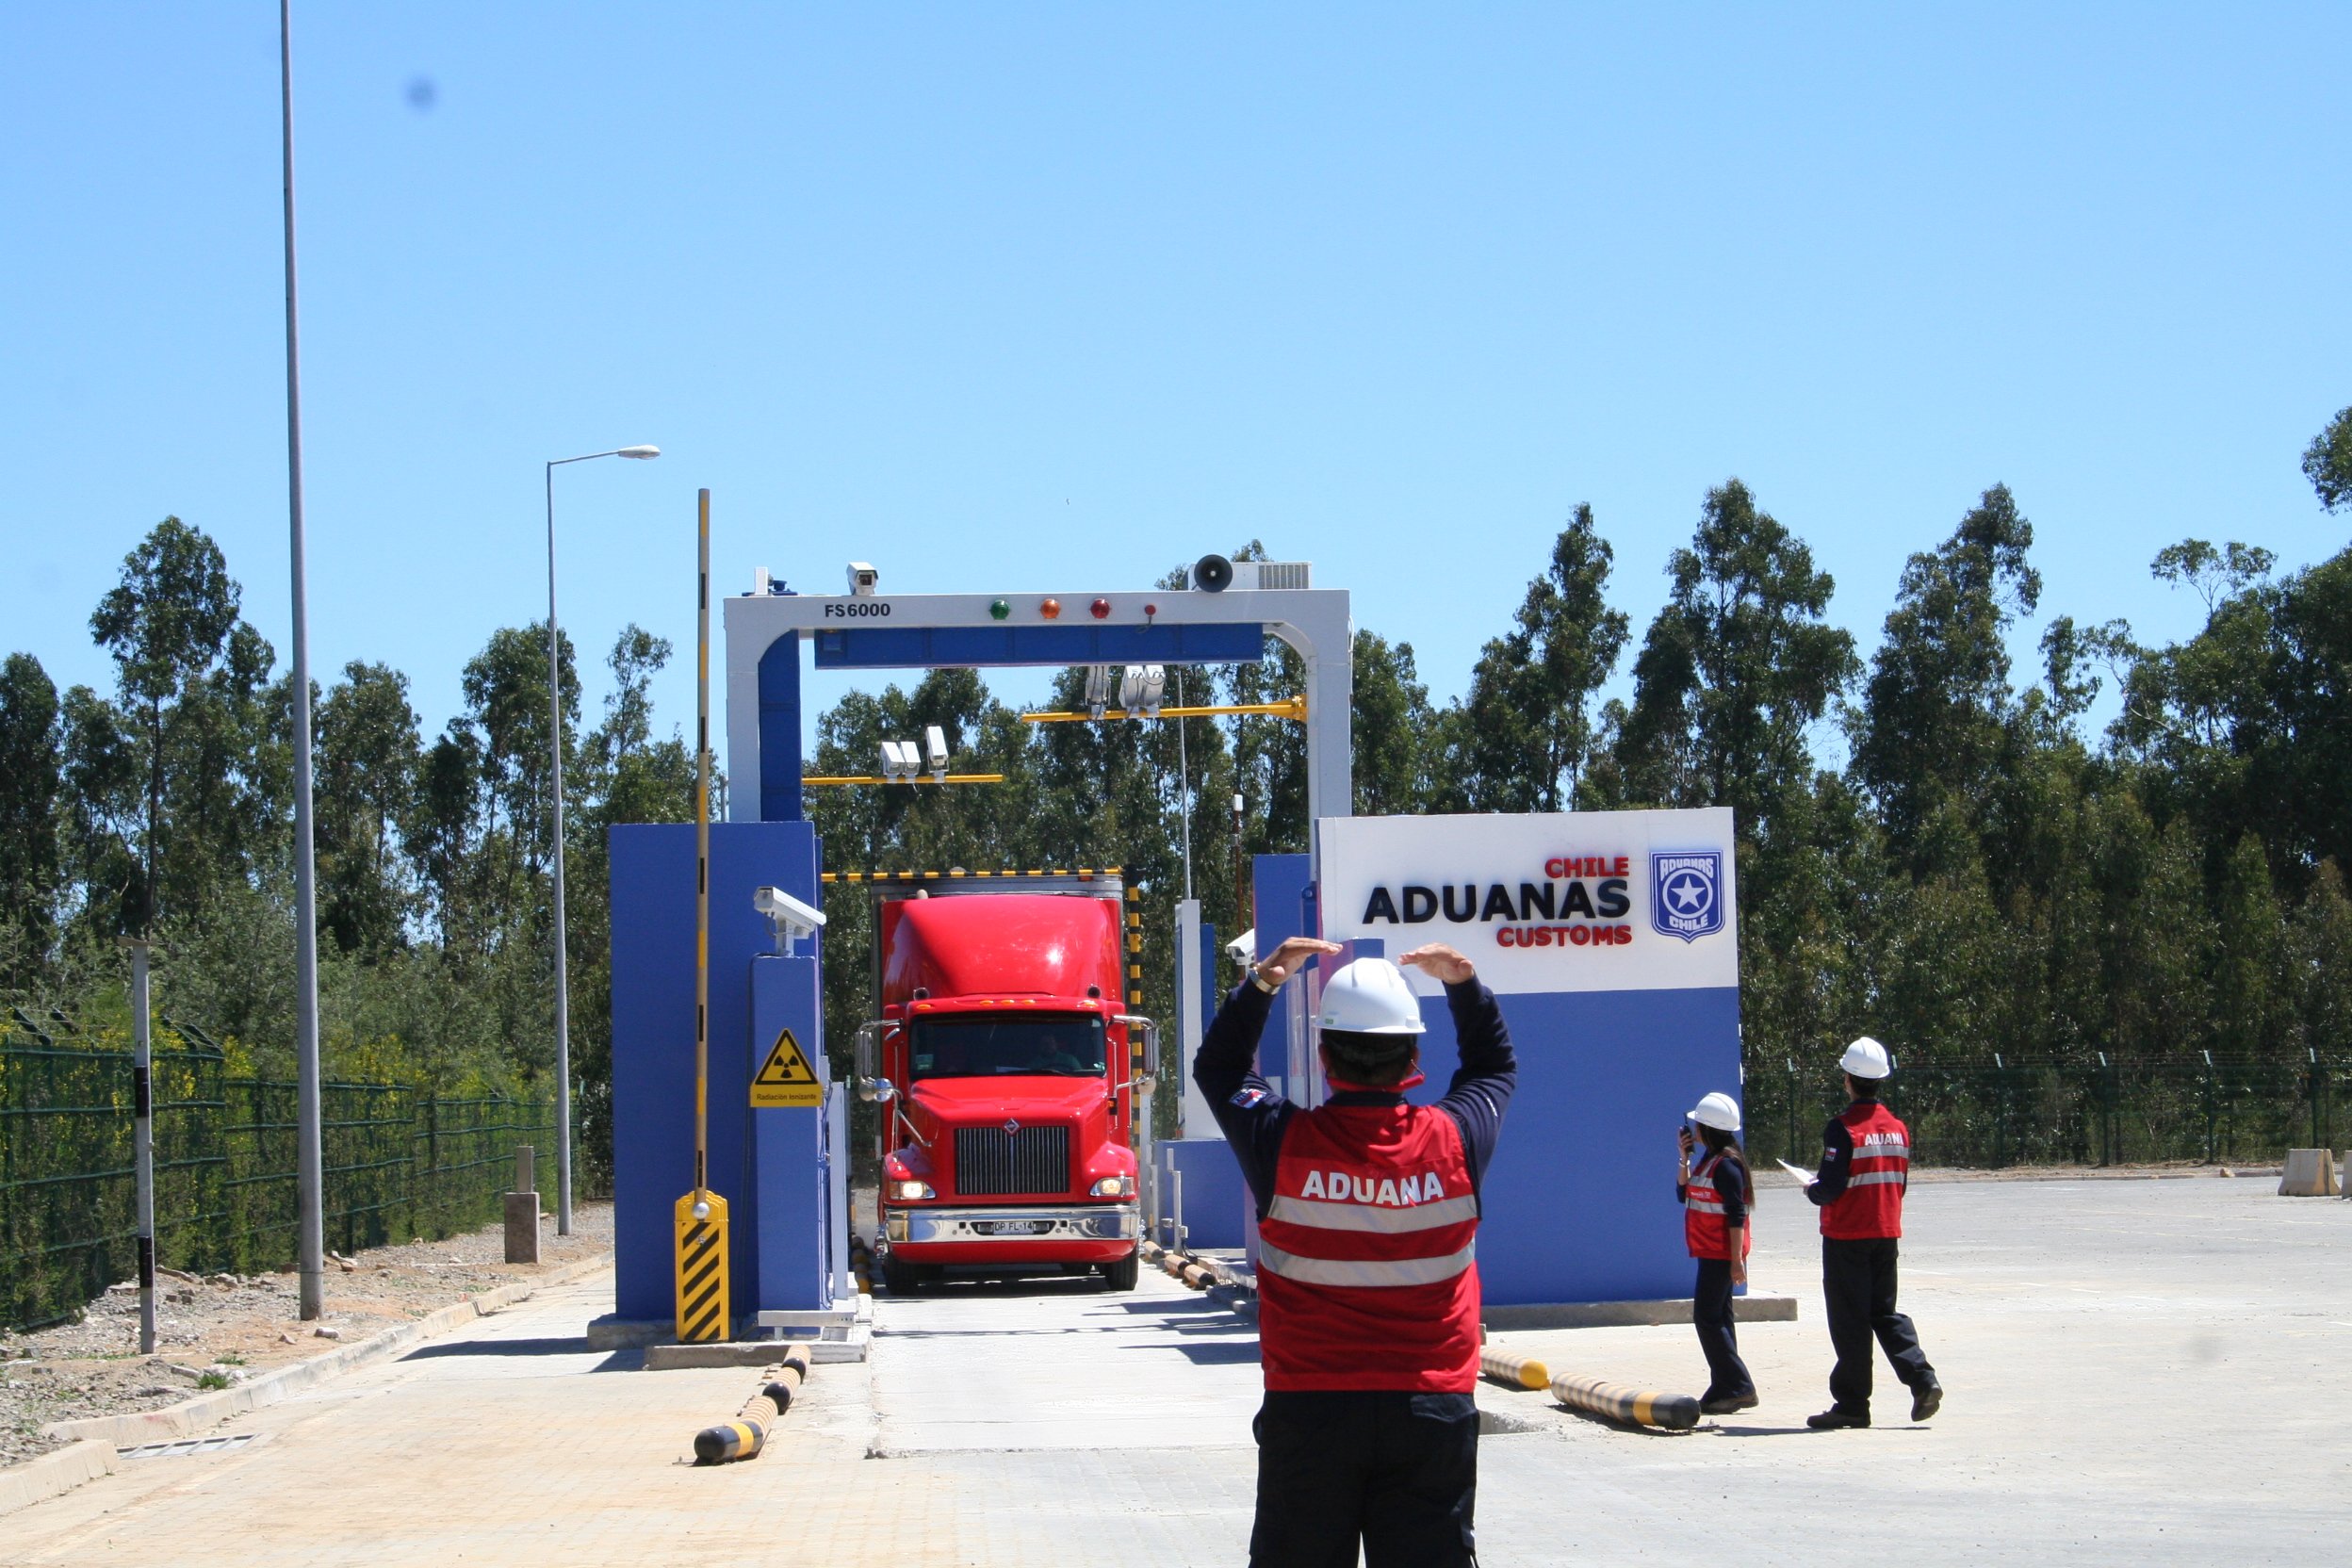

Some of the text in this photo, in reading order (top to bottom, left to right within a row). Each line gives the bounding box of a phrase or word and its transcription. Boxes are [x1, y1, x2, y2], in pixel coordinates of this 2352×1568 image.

[825, 603, 891, 617] FS6000
[1544, 857, 1629, 878] CHILE
[1659, 858, 1714, 882] ADUANAS
[1362, 879, 1631, 923] ADUANAS
[1669, 913, 1708, 931] CHILE
[1496, 924, 1632, 948] CUSTOMS
[1301, 1170, 1445, 1206] ADUANA
